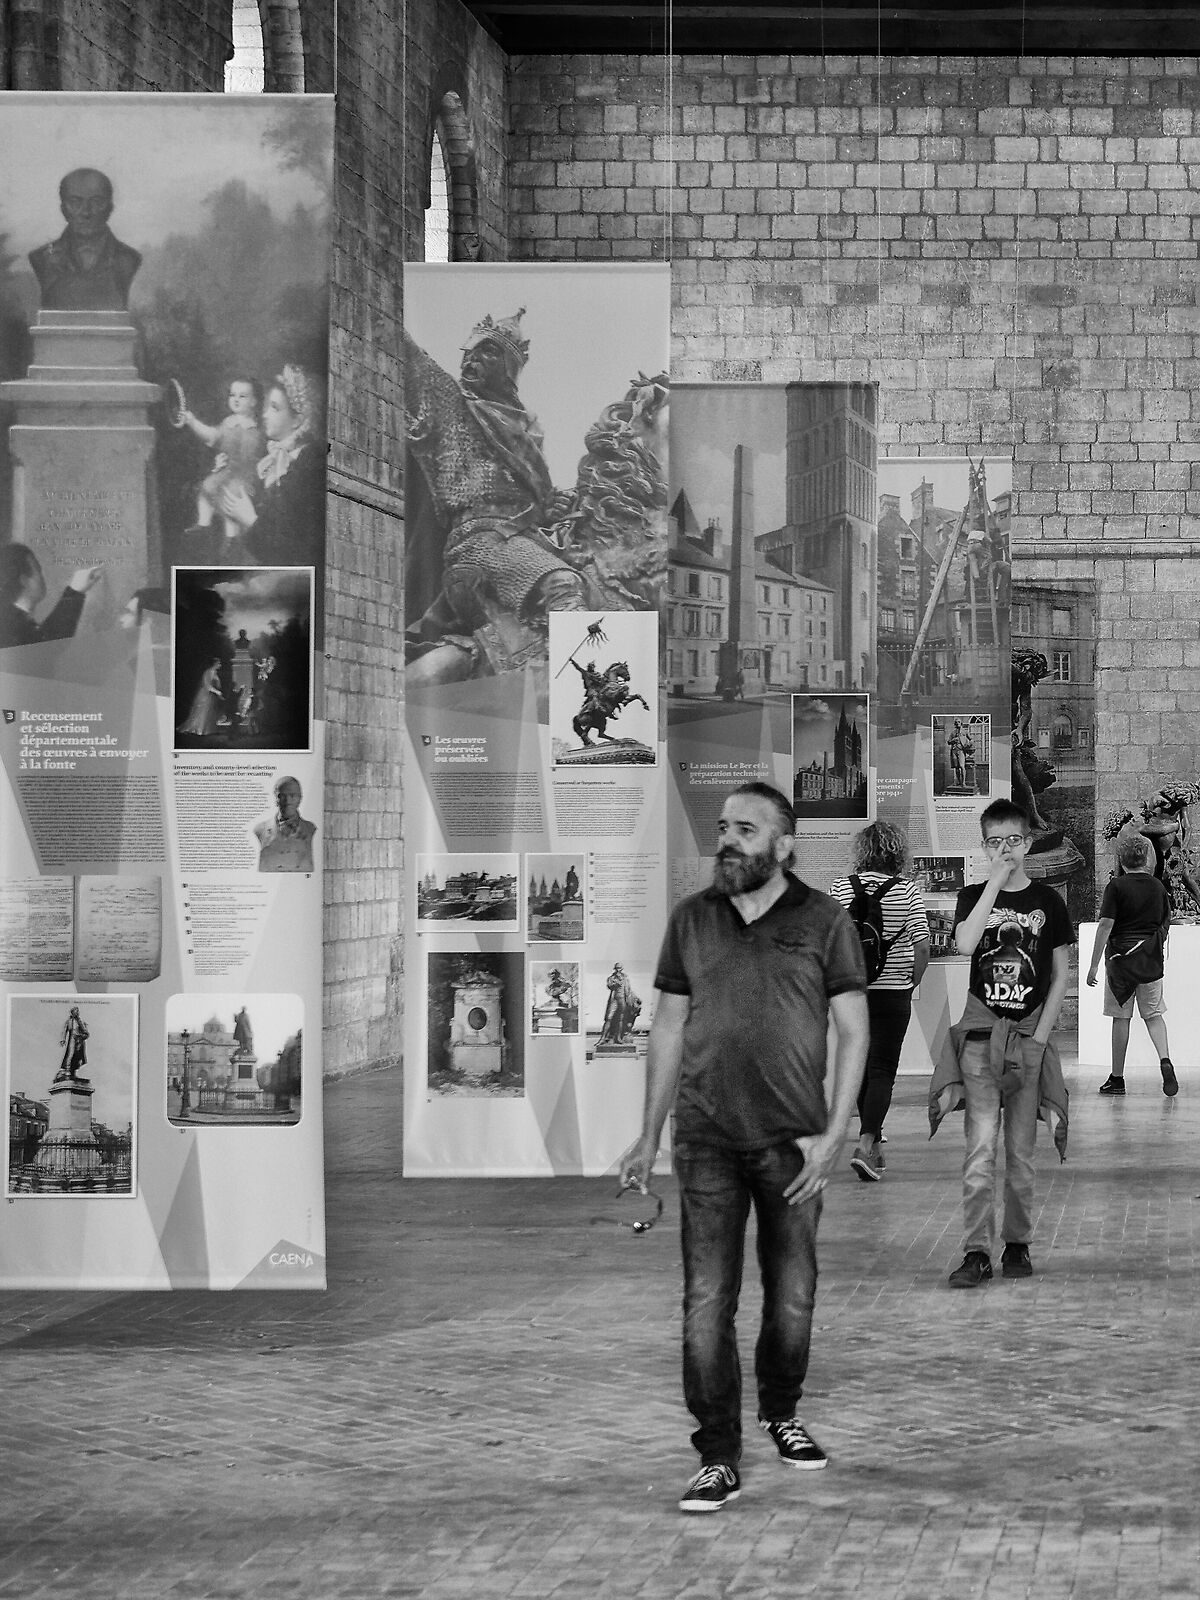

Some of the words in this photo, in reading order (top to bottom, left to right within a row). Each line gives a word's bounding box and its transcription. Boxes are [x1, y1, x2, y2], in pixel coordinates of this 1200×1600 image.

[6, 712, 14, 720] 3
[21, 711, 103, 721] Recensement
[21, 724, 33, 733] et
[35, 722, 90, 733] sélection
[21, 734, 118, 748] départementale
[20, 747, 41, 757] des
[43, 749, 88, 757] œuvres
[89, 746, 97, 757] à
[99, 749, 149, 760] envoyer
[20, 759, 28, 769] à
[30, 758, 41, 769] la
[44, 758, 77, 769] fonte
[733, 770, 769, 778] technique
